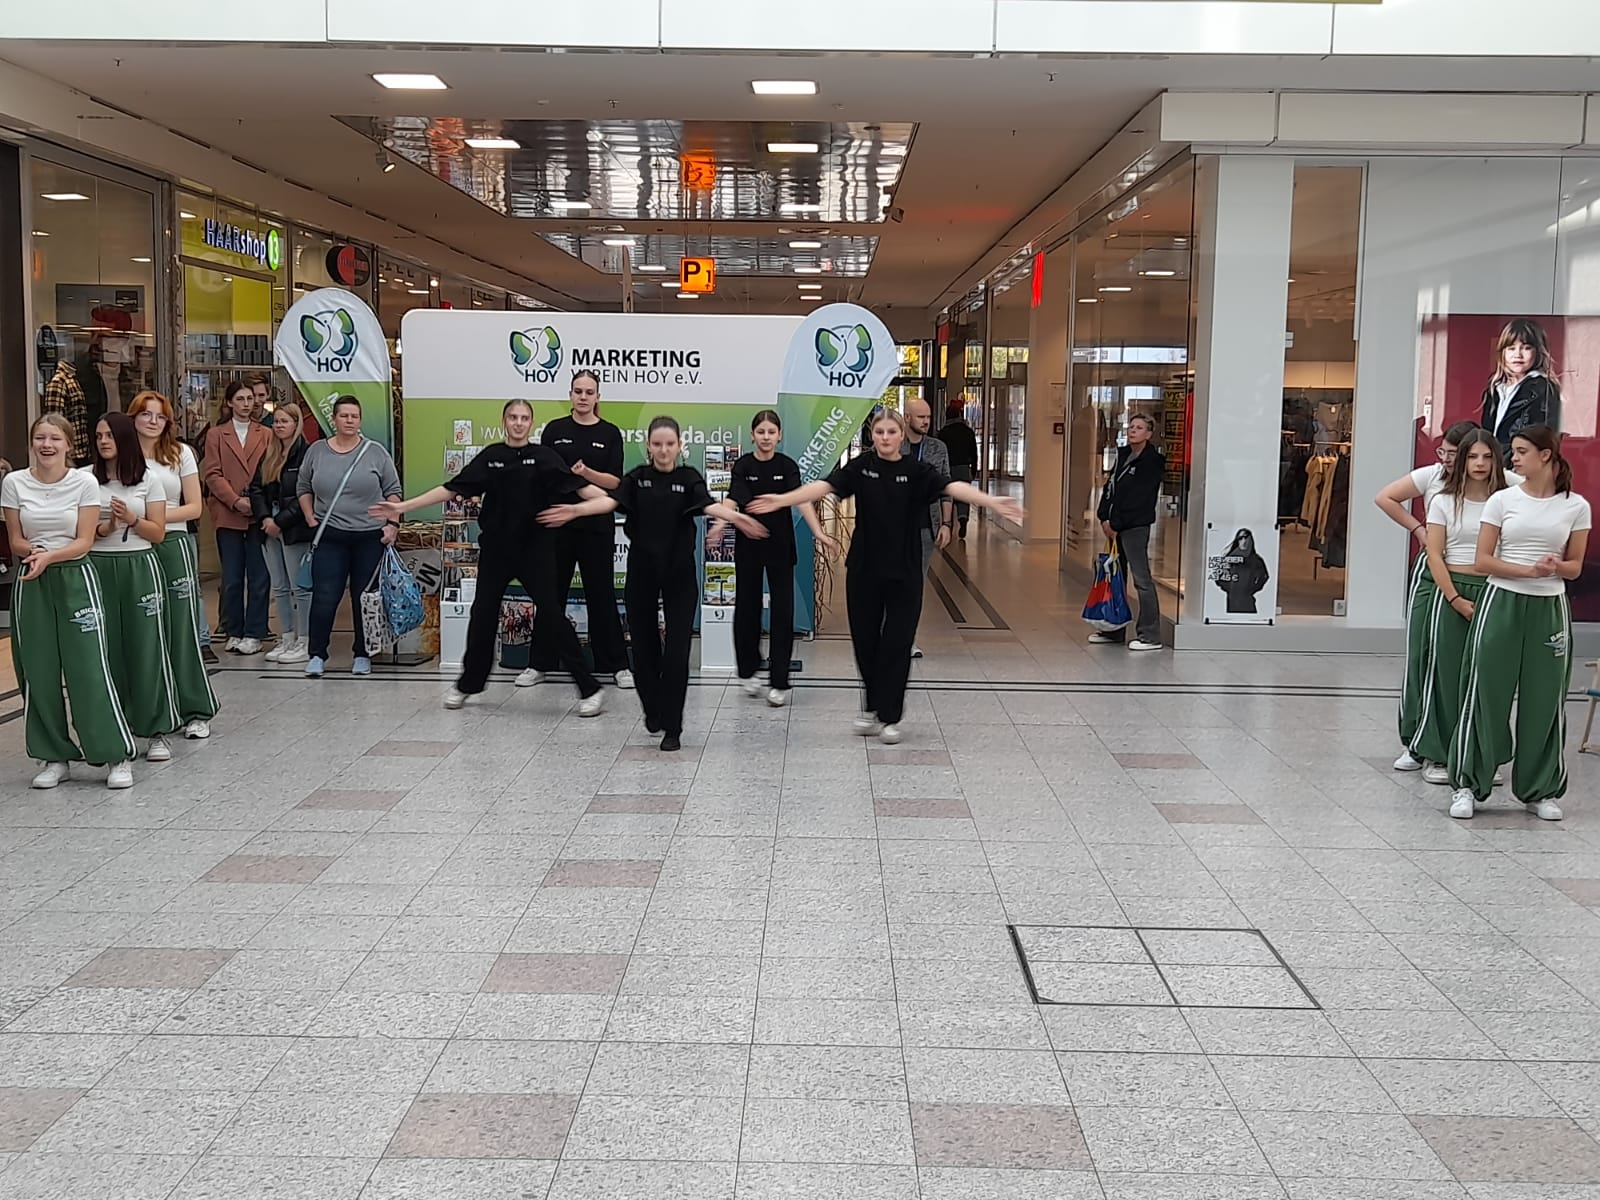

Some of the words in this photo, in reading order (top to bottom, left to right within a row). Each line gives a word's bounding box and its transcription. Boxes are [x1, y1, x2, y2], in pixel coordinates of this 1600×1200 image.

[206, 217, 267, 265] HAARshop
[683, 260, 701, 283] P
[705, 269, 712, 284] 1
[316, 357, 353, 373] HOY
[570, 348, 702, 368] MARKETING
[524, 369, 558, 383] HOY
[634, 369, 670, 384] HOY
[674, 370, 703, 385] e.V.
[828, 370, 867, 389] HOY
[820, 434, 841, 460] HOY
